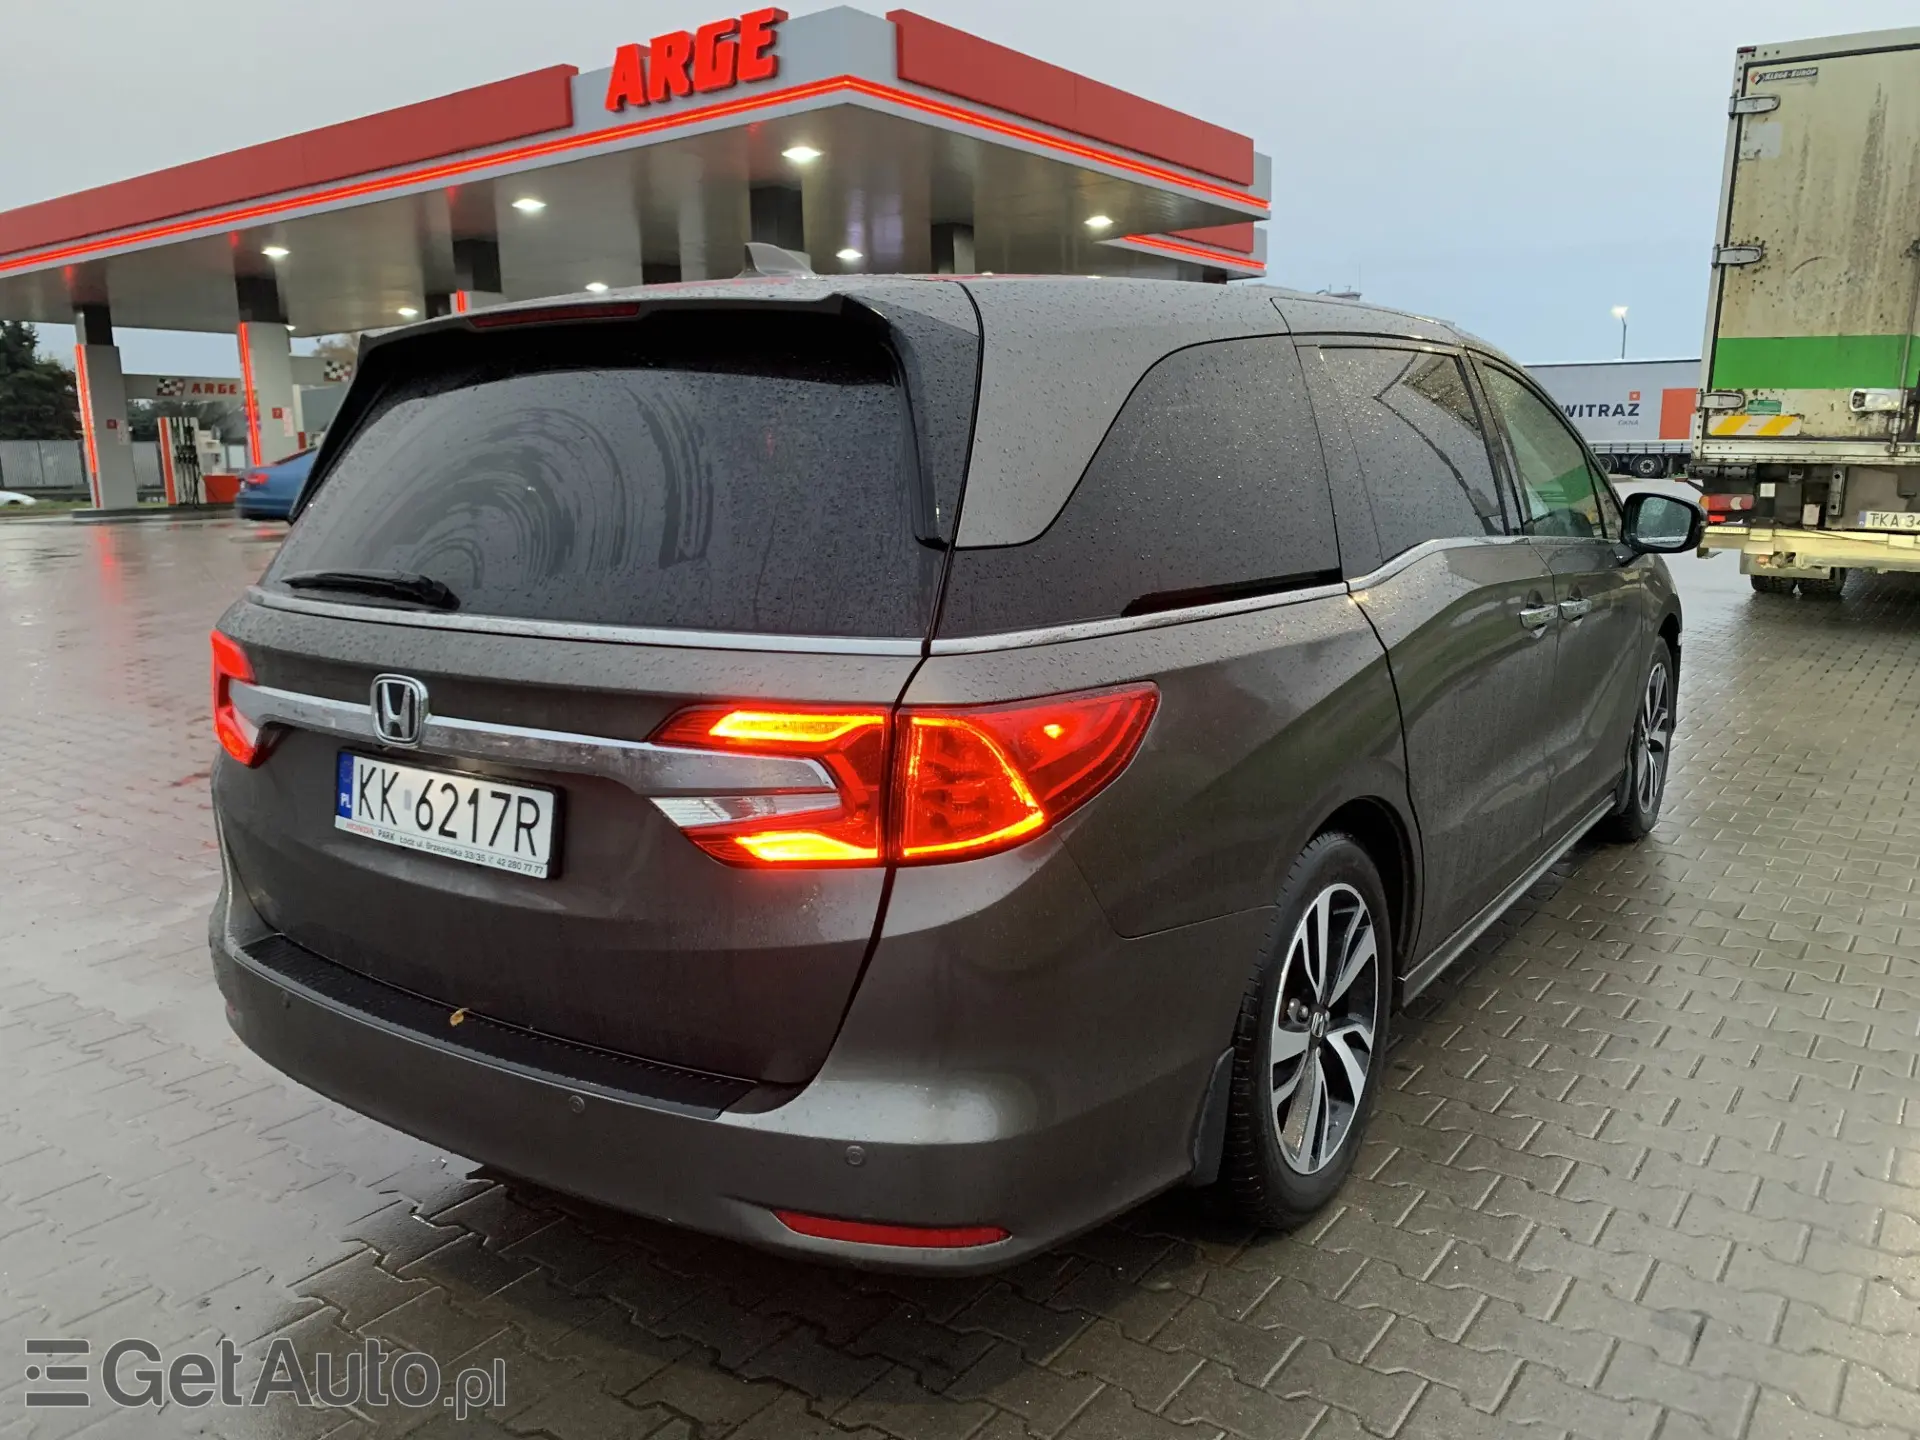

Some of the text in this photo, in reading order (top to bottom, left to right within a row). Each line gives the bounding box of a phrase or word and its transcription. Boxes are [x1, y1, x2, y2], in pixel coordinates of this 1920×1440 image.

[605, 7, 788, 113] ARGE
[191, 382, 238, 396] ARGE
[1870, 513, 1899, 528] TKA
[358, 764, 540, 857] KK 6217R
